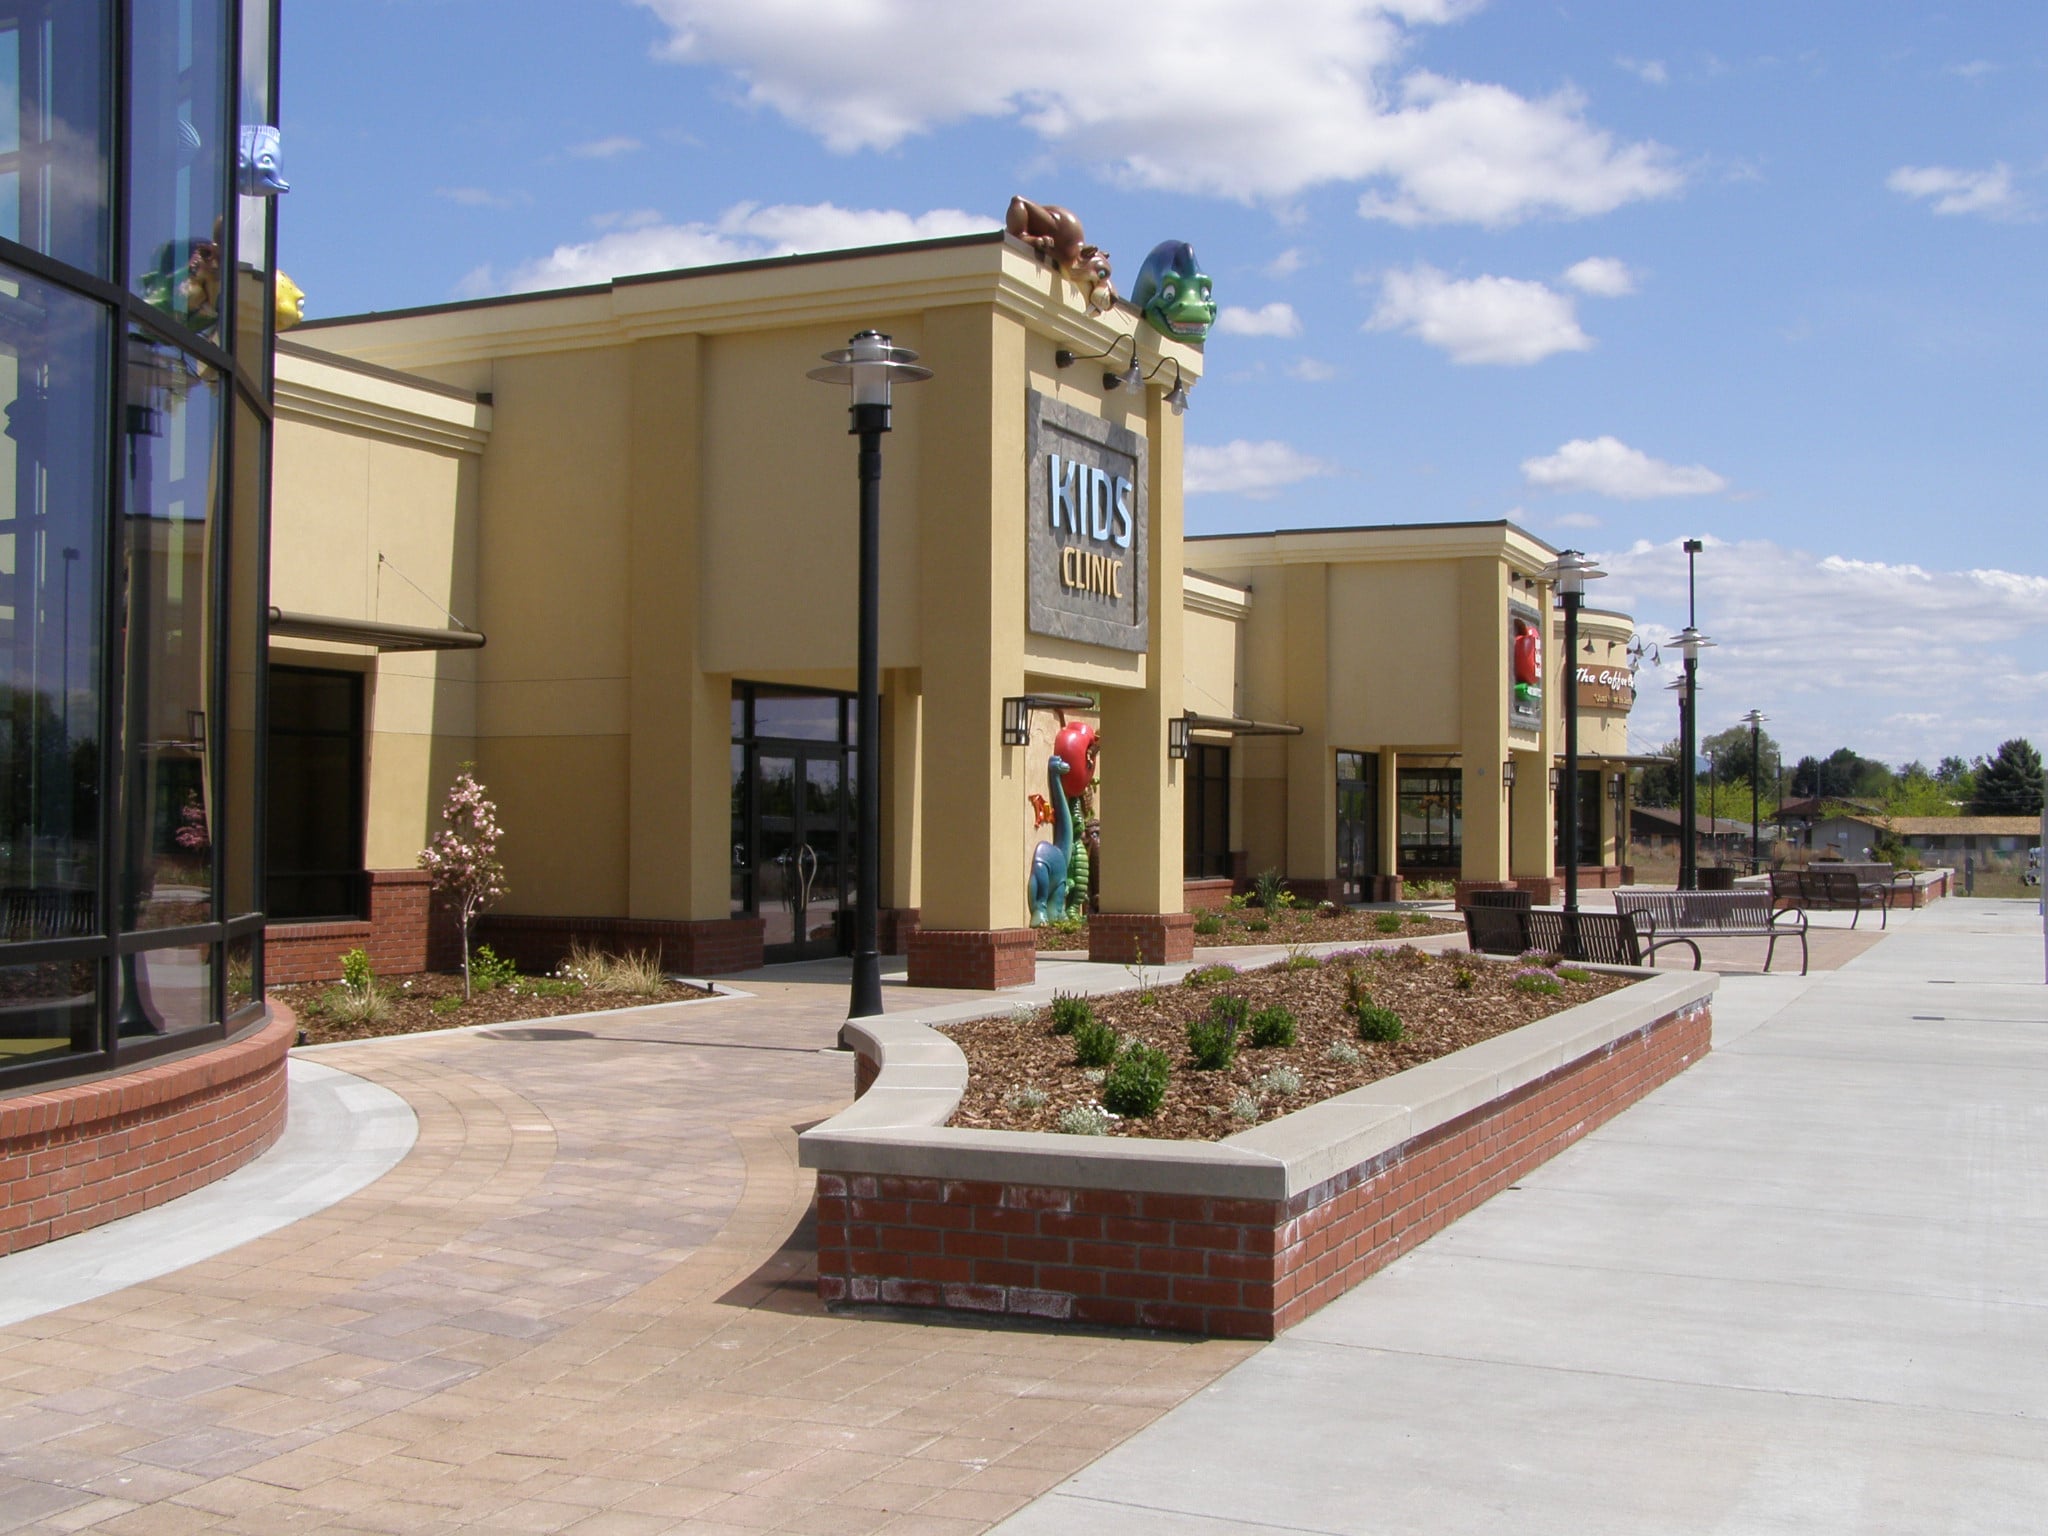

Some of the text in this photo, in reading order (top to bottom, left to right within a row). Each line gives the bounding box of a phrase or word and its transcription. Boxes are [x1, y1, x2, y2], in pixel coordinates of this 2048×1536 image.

[1049, 453, 1133, 548] KIDS
[1062, 546, 1123, 599] CLINIC
[1576, 667, 1596, 684] The
